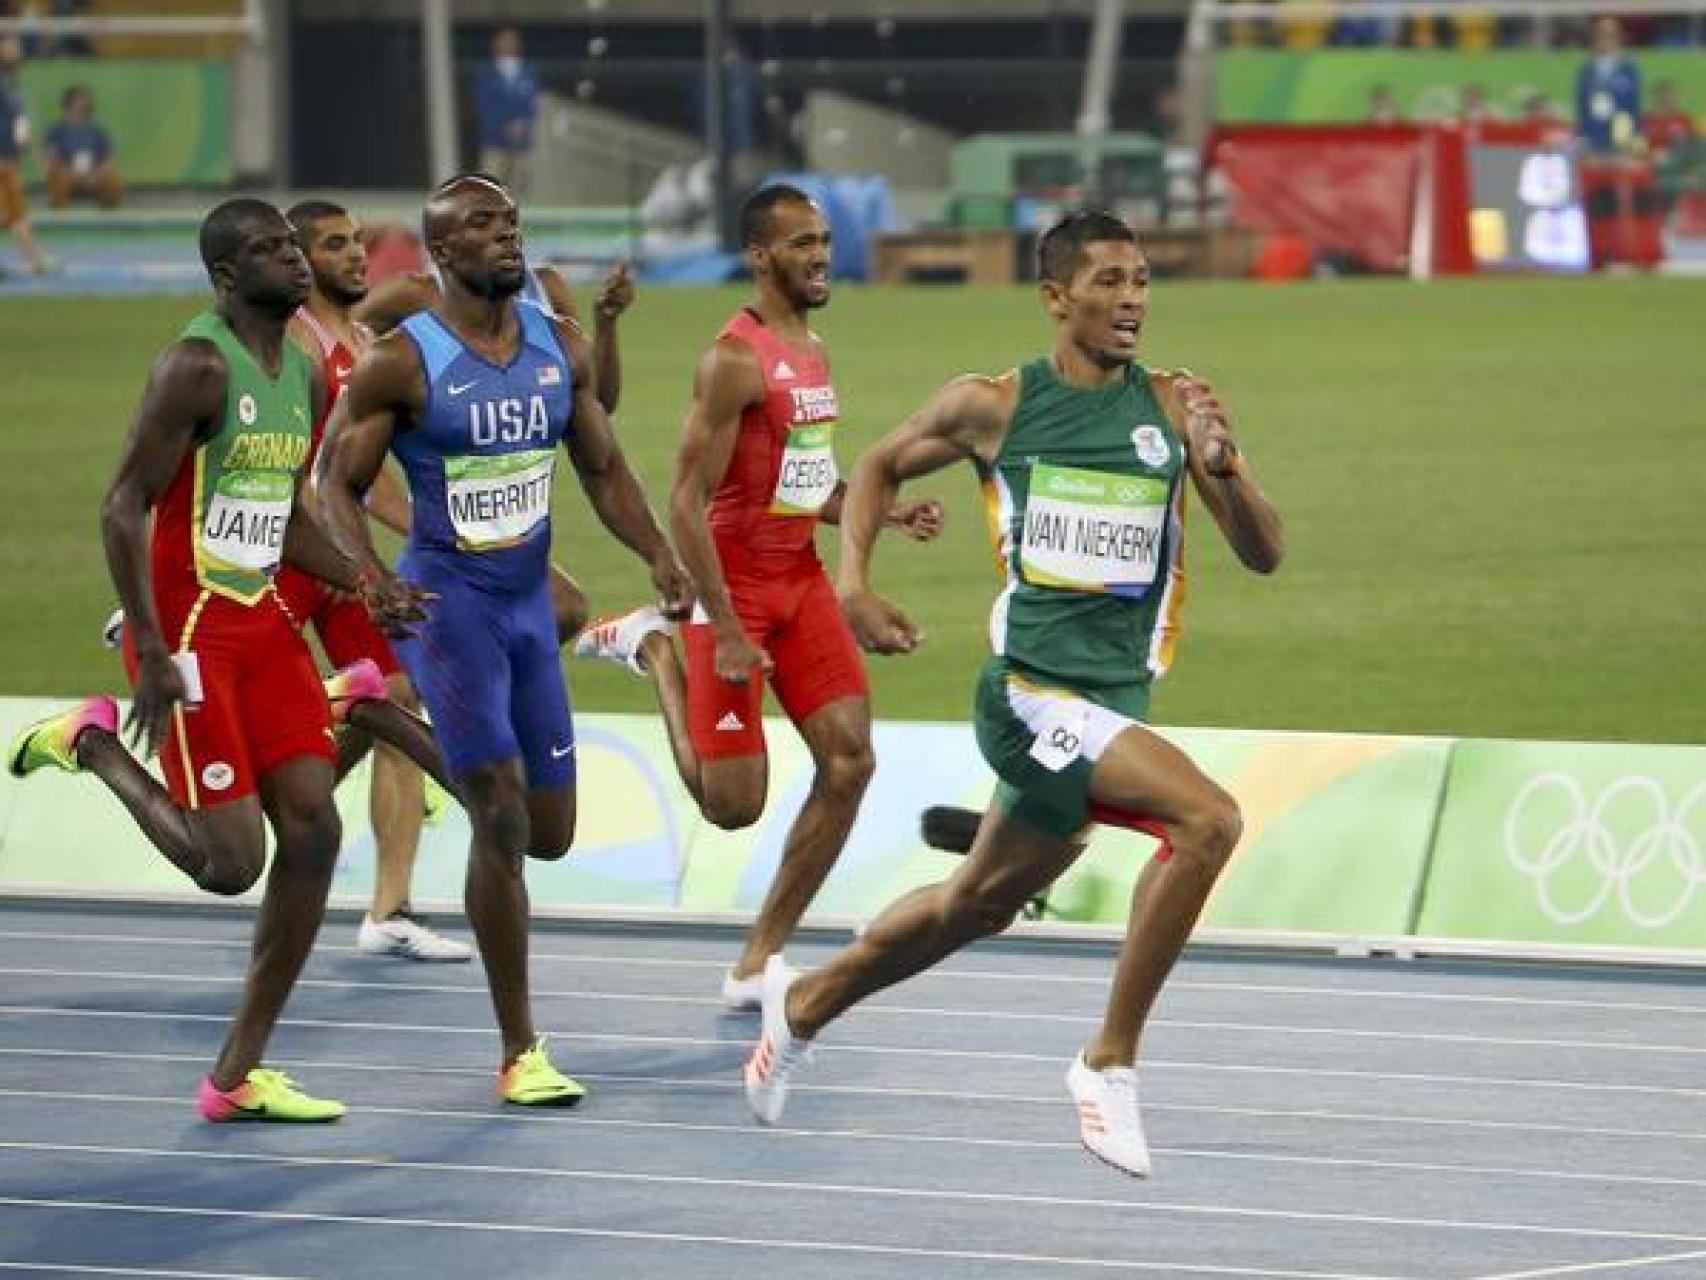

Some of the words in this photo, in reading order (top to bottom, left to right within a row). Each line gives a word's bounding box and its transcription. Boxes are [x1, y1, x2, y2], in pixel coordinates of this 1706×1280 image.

[470, 395, 549, 446] USA
[450, 472, 552, 523] MERRITT
[1028, 511, 1069, 554] VAN
[1075, 515, 1160, 564] NIEKERK
[1052, 726, 1079, 753] 8
